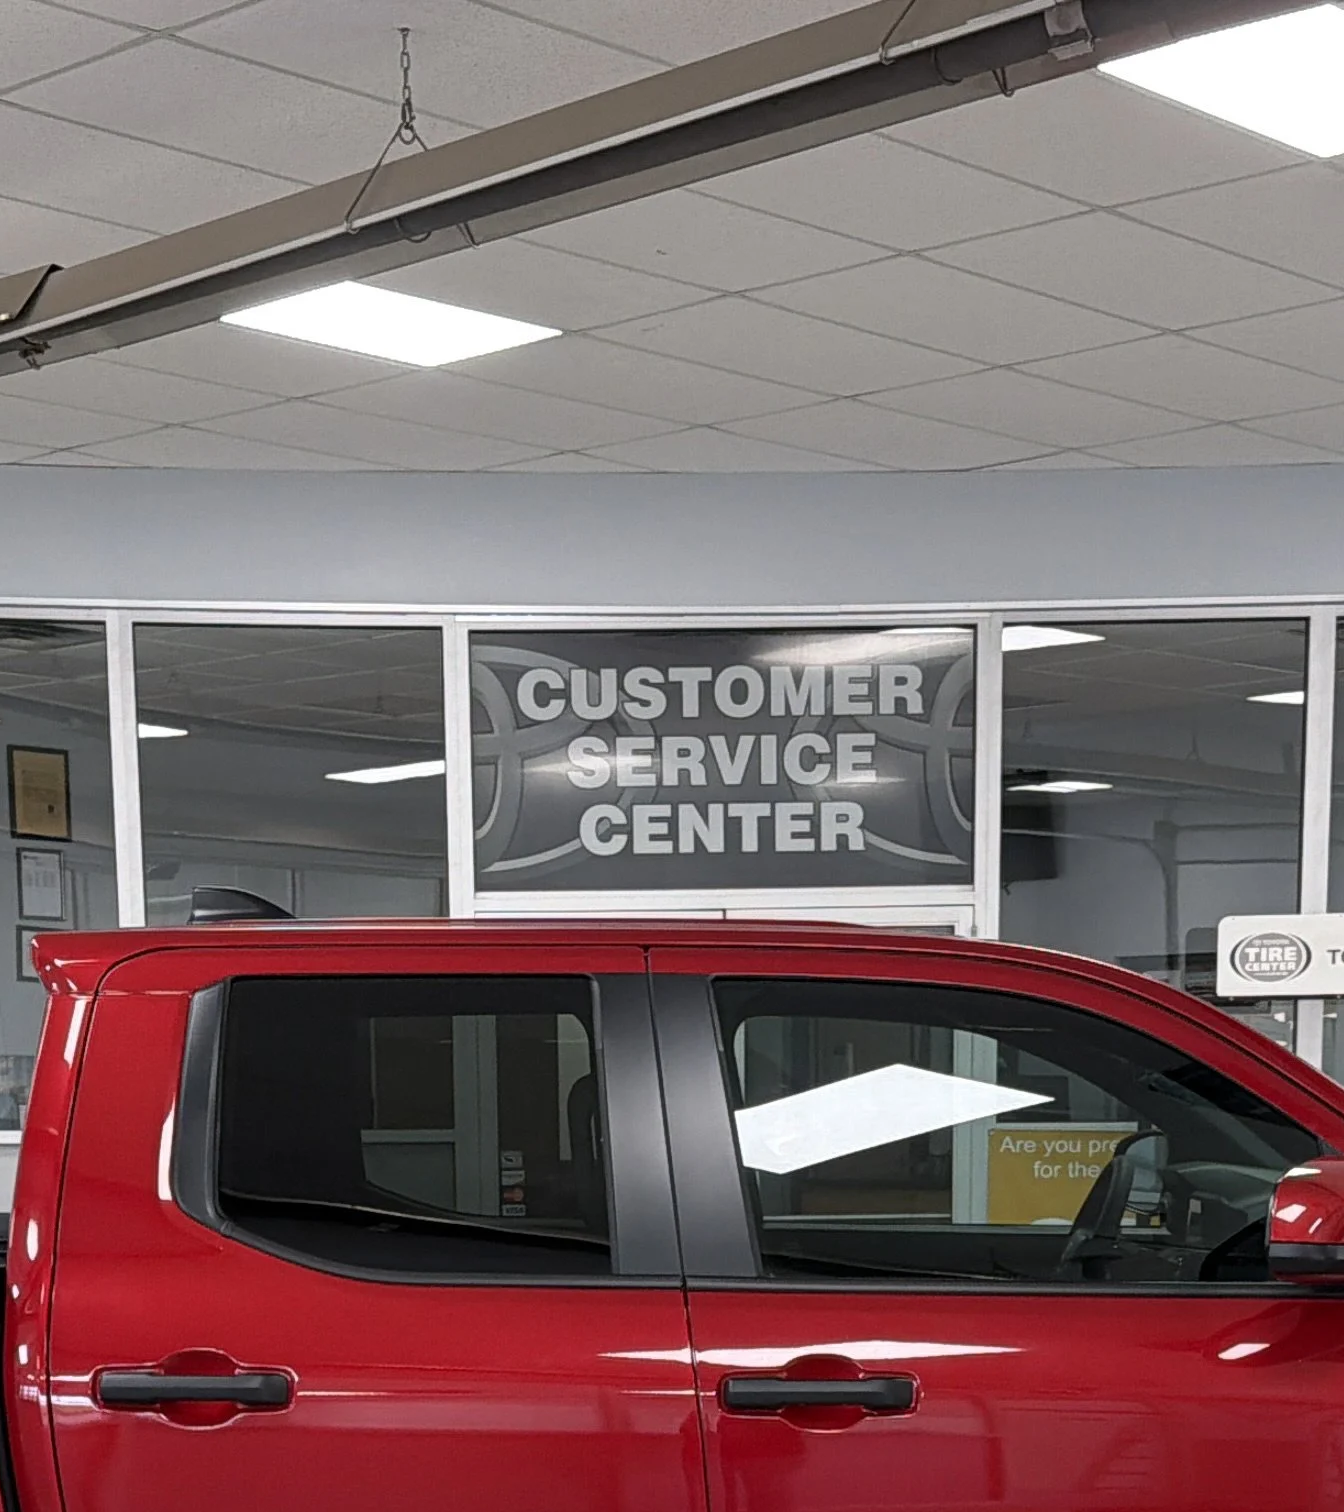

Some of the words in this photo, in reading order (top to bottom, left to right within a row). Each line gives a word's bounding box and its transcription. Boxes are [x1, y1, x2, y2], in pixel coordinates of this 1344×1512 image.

[517, 664, 924, 721] CUSTOMER
[566, 732, 877, 788] SERVICE
[578, 800, 866, 856] CENTER
[1244, 946, 1297, 962] TIRE
[1244, 961, 1296, 972] CENTER
[1000, 1135, 1037, 1153] Are
[1043, 1139, 1081, 1157] you
[1033, 1161, 1062, 1179] for
[1068, 1161, 1102, 1179] the
